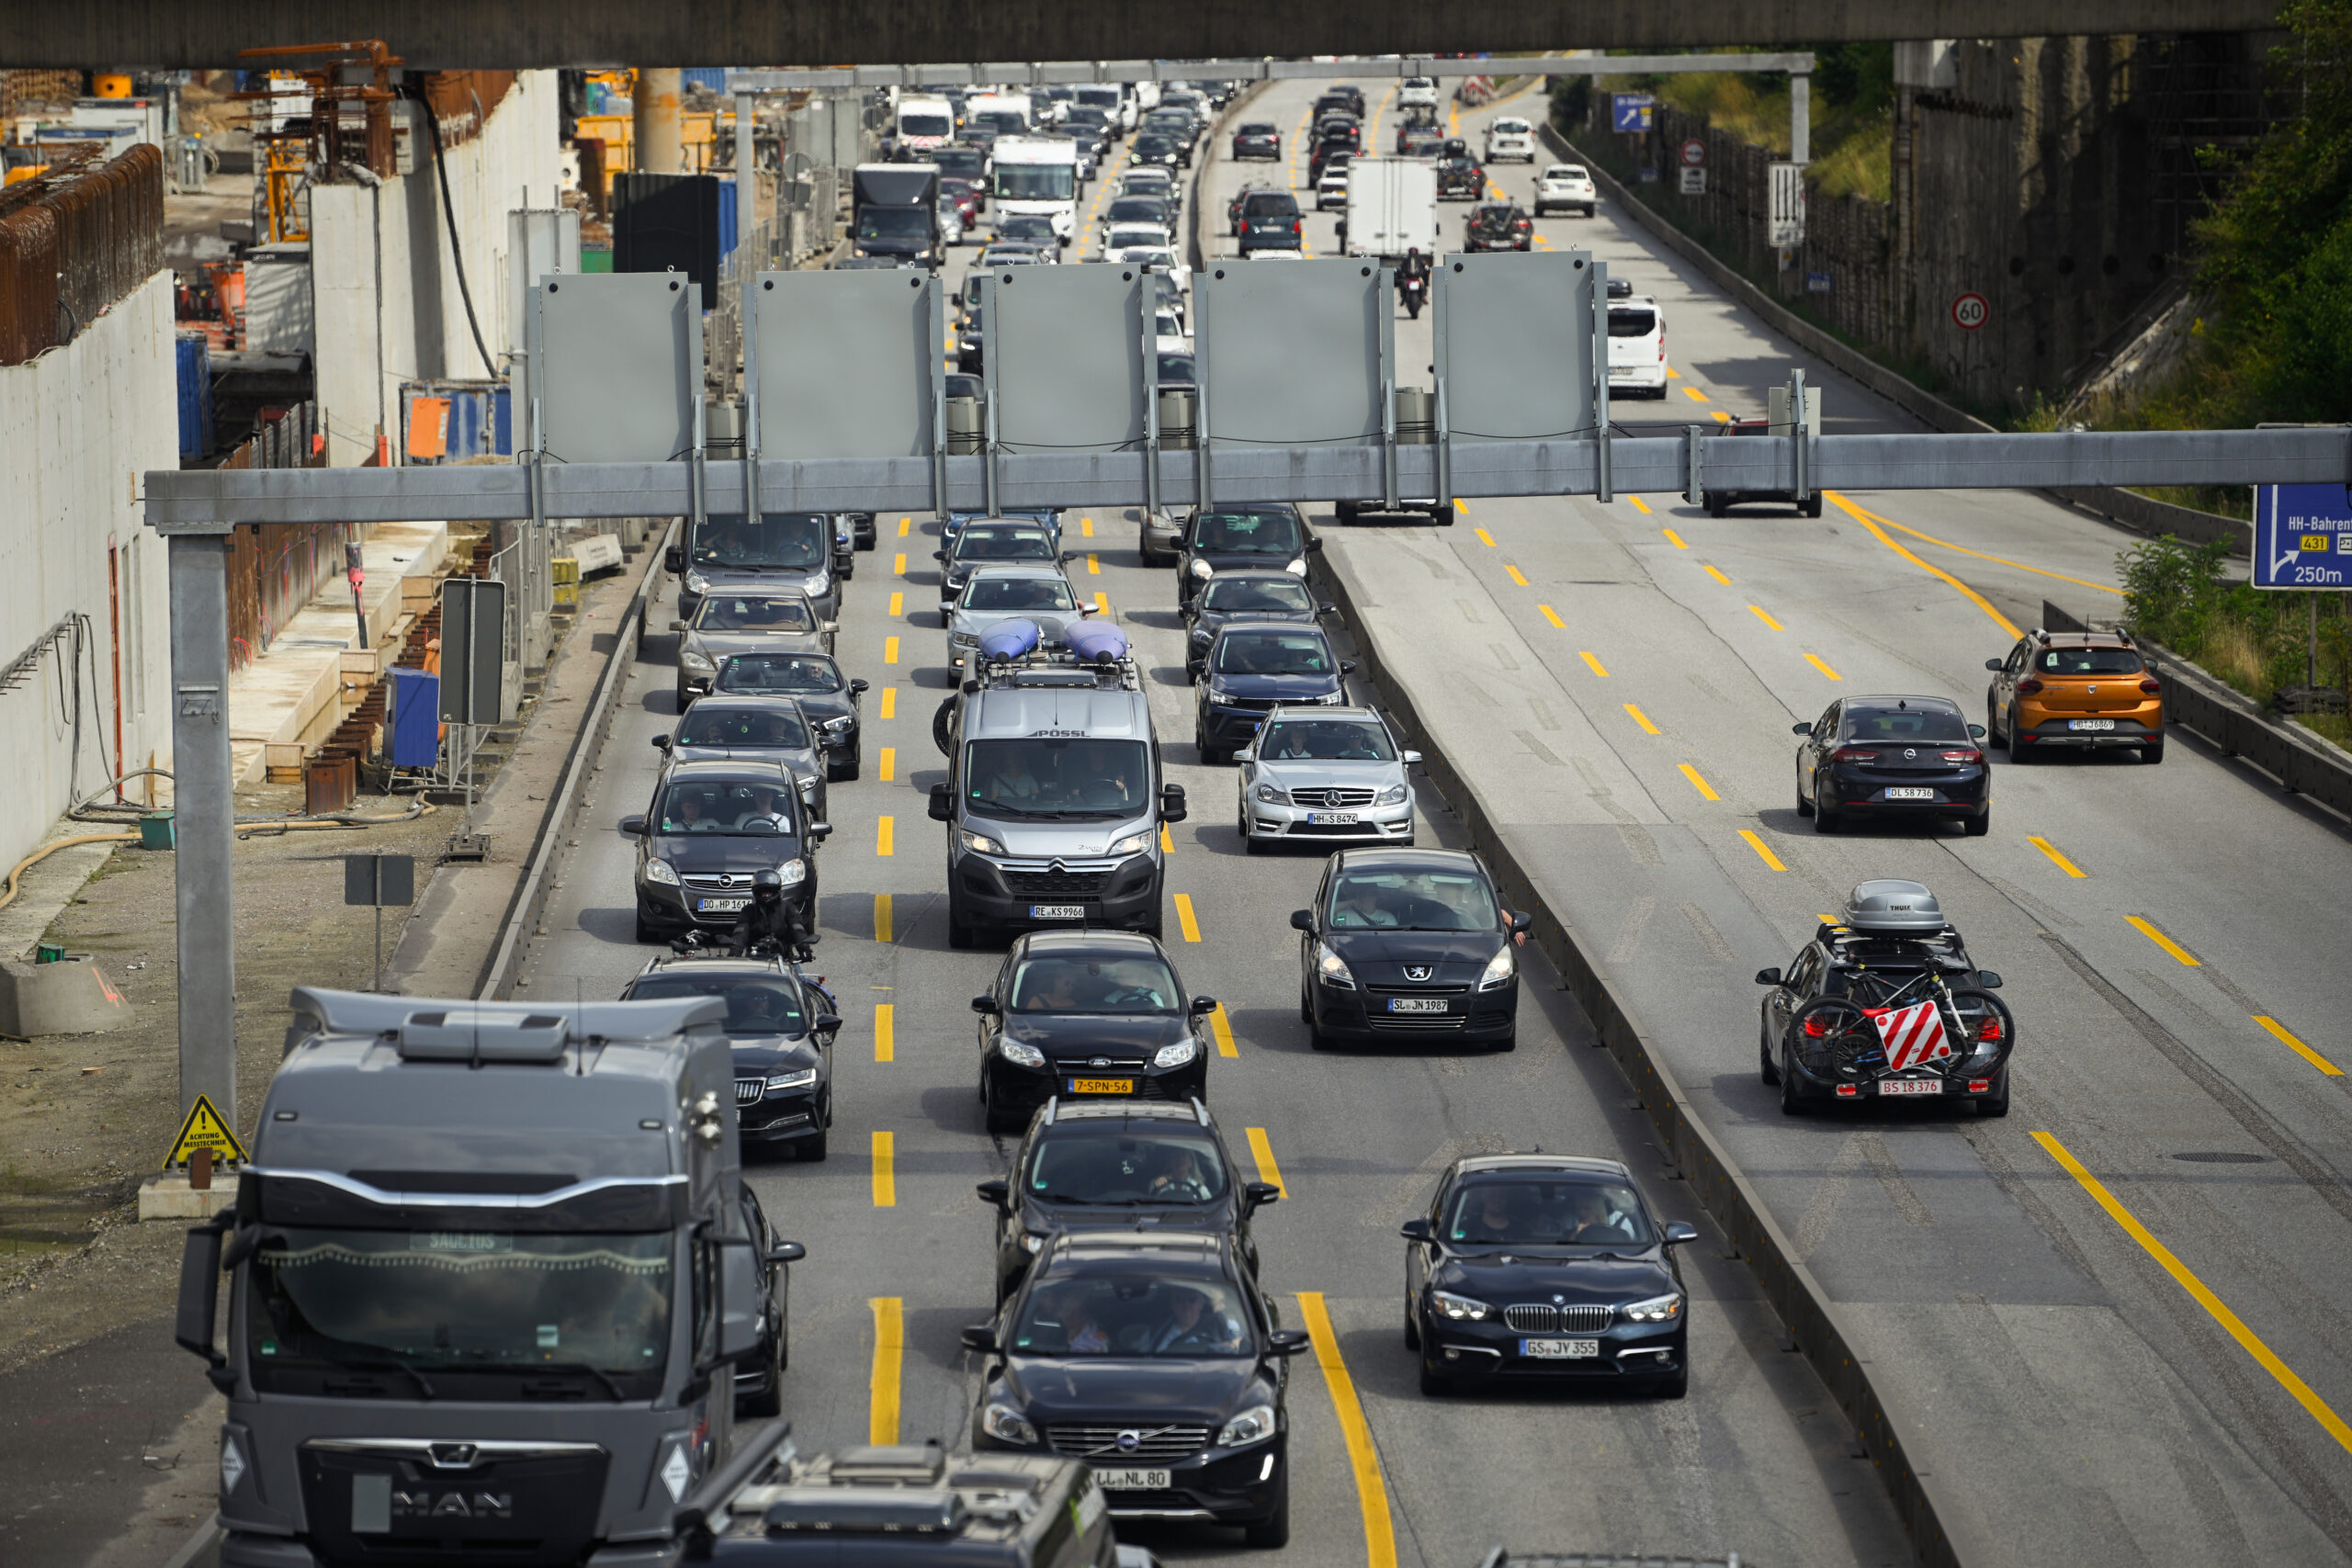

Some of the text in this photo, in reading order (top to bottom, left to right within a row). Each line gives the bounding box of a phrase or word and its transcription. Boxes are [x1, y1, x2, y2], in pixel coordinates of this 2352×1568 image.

[1960, 302, 1982, 321] 60
[2289, 516, 2352, 531] HH-Bahren
[2304, 537, 2324, 549] 431
[2295, 566, 2342, 582] 250m
[1038, 729, 1091, 738] PÖSSL
[1891, 788, 1932, 797] DL 58 736
[1313, 815, 1357, 824] HH S 8474
[704, 899, 714, 908] DO
[719, 900, 730, 909] HP
[1035, 907, 1083, 917] RE KS 9966
[1394, 999, 1447, 1010] SL JN 1987
[1077, 1081, 1128, 1091] 7-SPN-56
[1883, 1081, 1938, 1093] BS 18 376
[189, 1132, 220, 1140] ACHTUNG
[184, 1139, 226, 1148] MESSTECHNIK
[1528, 1341, 1597, 1355] GS JY 355
[1097, 1472, 1166, 1486] LL NL 80
[392, 1492, 513, 1517] MAN
